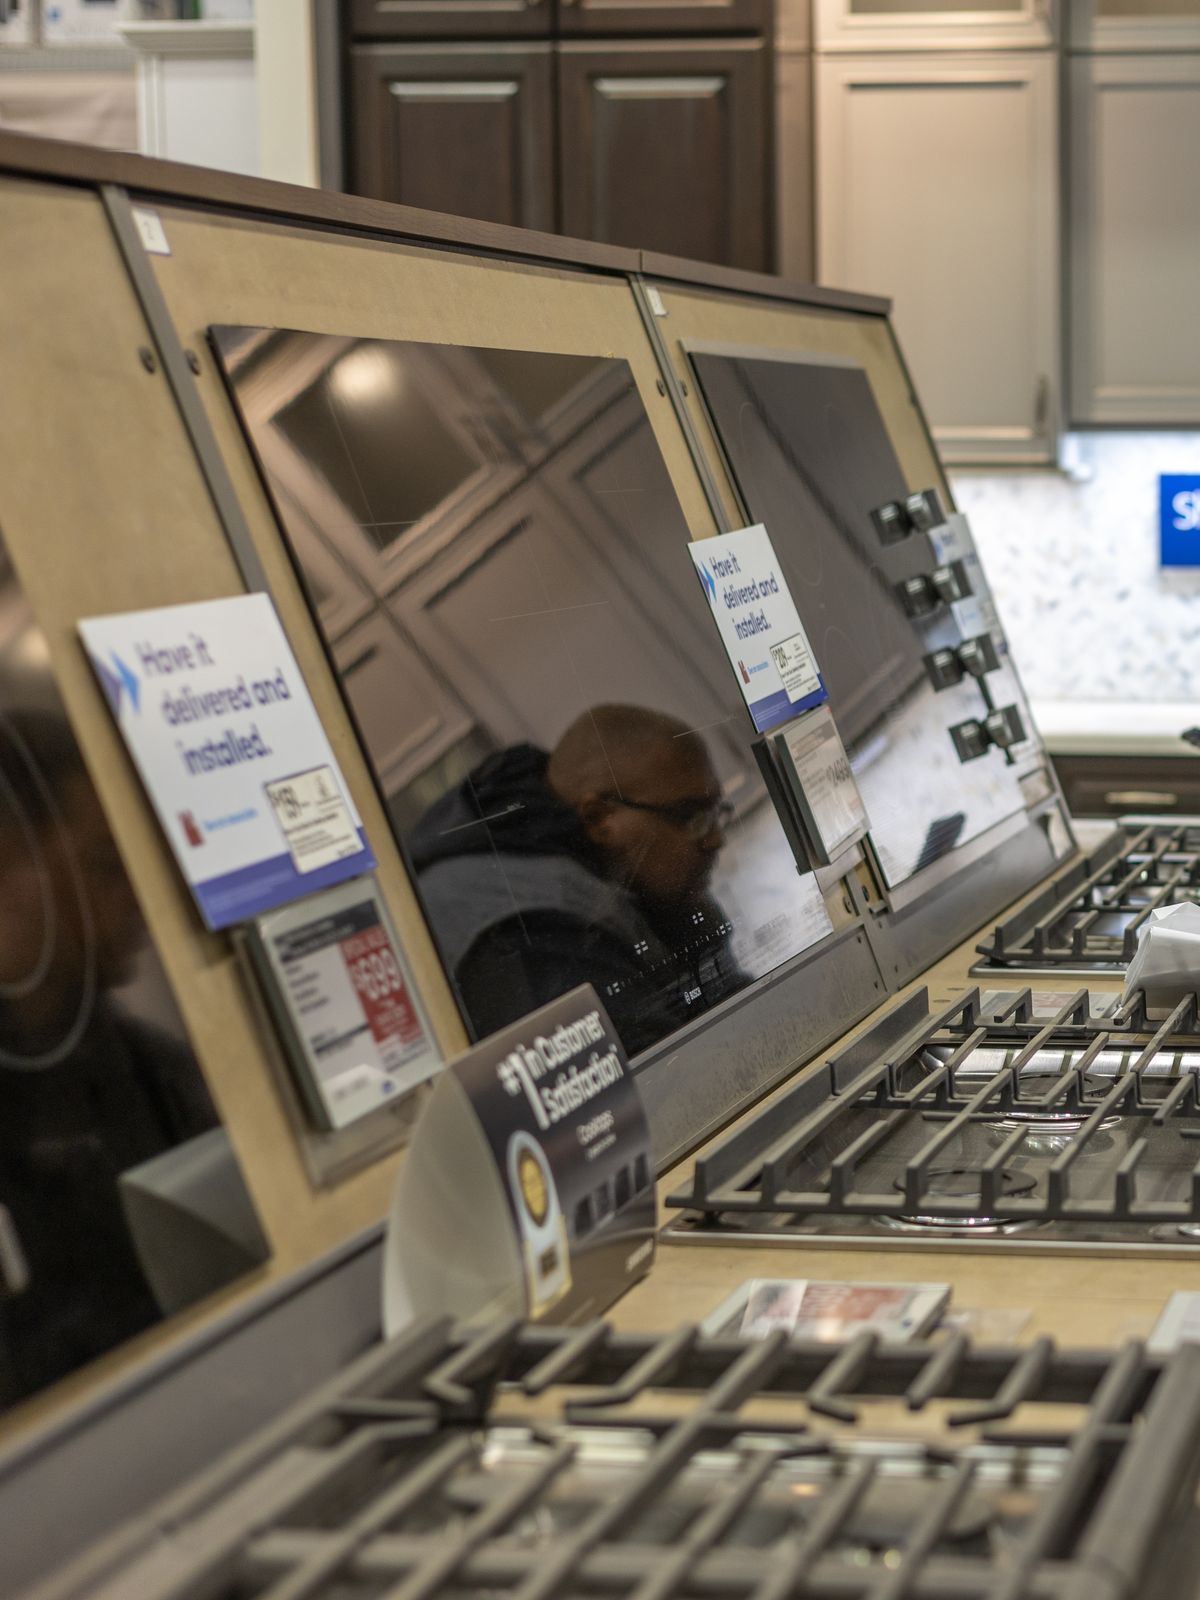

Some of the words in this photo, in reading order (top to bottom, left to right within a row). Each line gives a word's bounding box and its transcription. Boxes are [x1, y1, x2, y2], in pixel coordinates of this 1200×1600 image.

[709, 556, 734, 580] Have
[727, 550, 742, 573] it
[723, 577, 761, 609] delivered
[759, 572, 780, 597] and
[732, 609, 772, 641] installed.
[139, 638, 196, 676] Have
[190, 633, 215, 666] it
[162, 677, 253, 726] delivered
[254, 667, 292, 708] and
[177, 724, 273, 776] installed.
[514, 1043, 548, 1081] in
[534, 1010, 606, 1071] Customer
